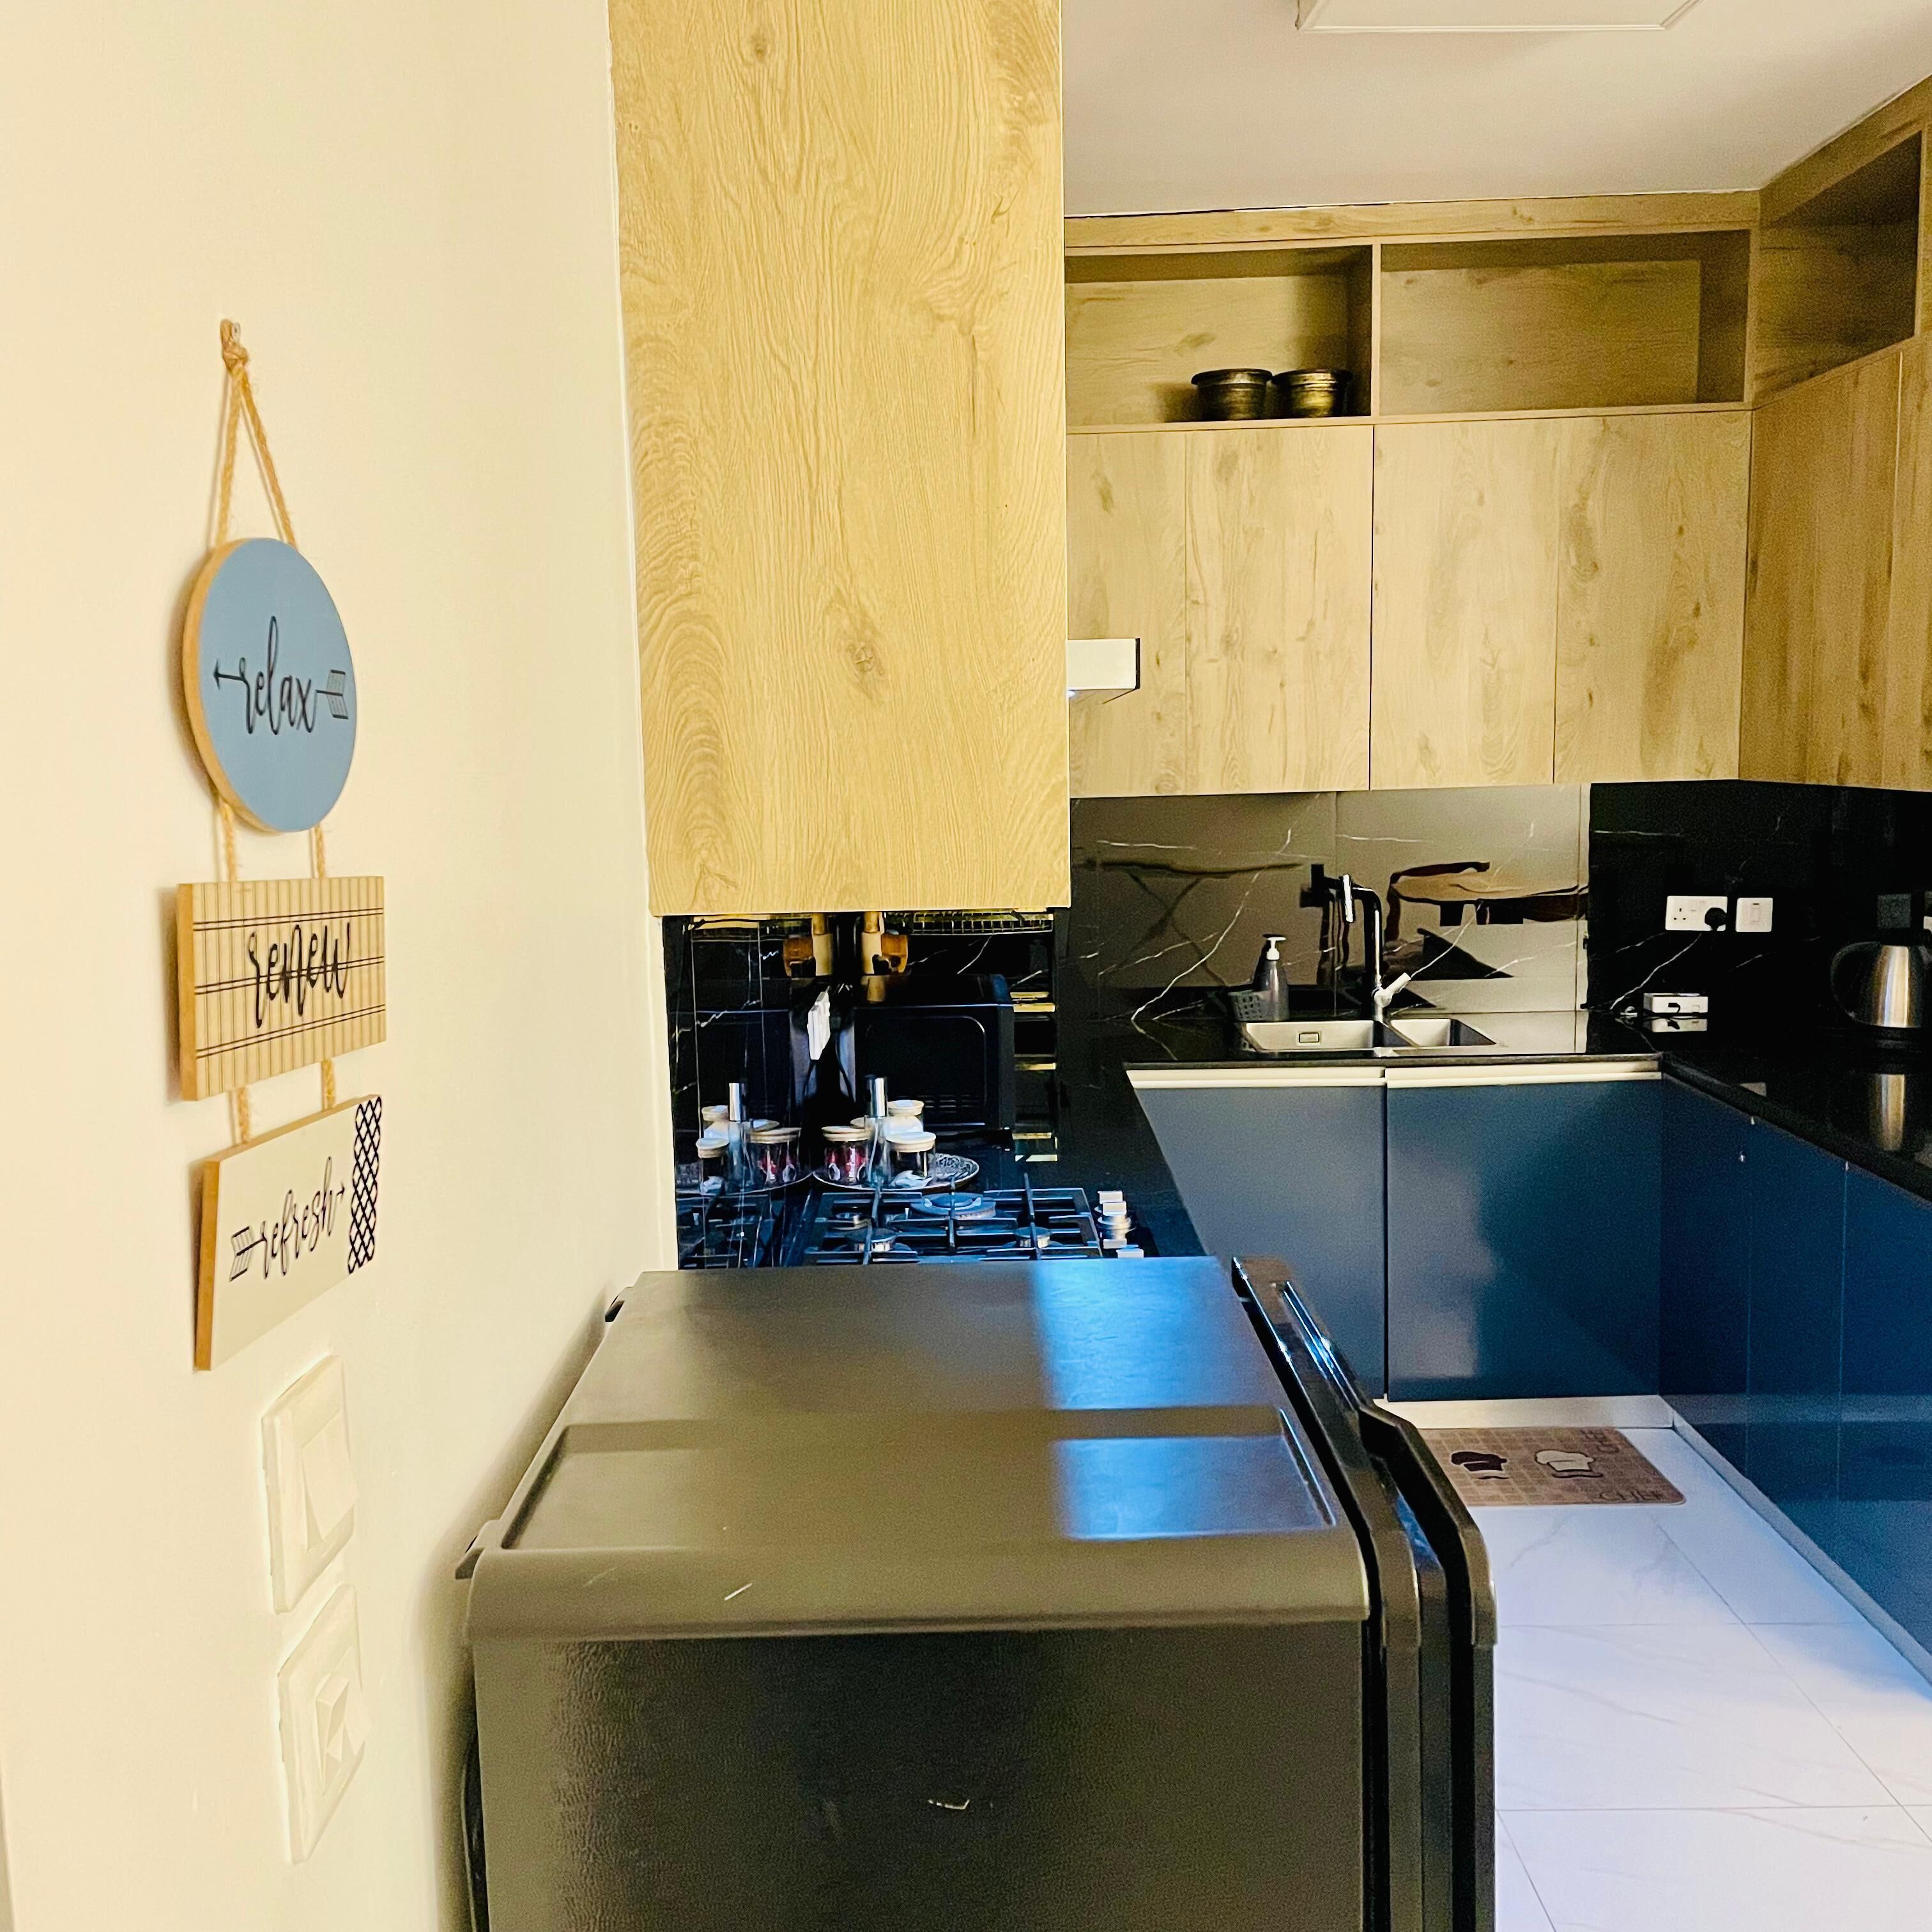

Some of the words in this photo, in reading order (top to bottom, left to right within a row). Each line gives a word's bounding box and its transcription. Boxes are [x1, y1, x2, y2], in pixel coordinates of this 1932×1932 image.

[239, 615, 319, 735] relax
[248, 922, 350, 1029] renew
[259, 1156, 338, 1280] refresh
